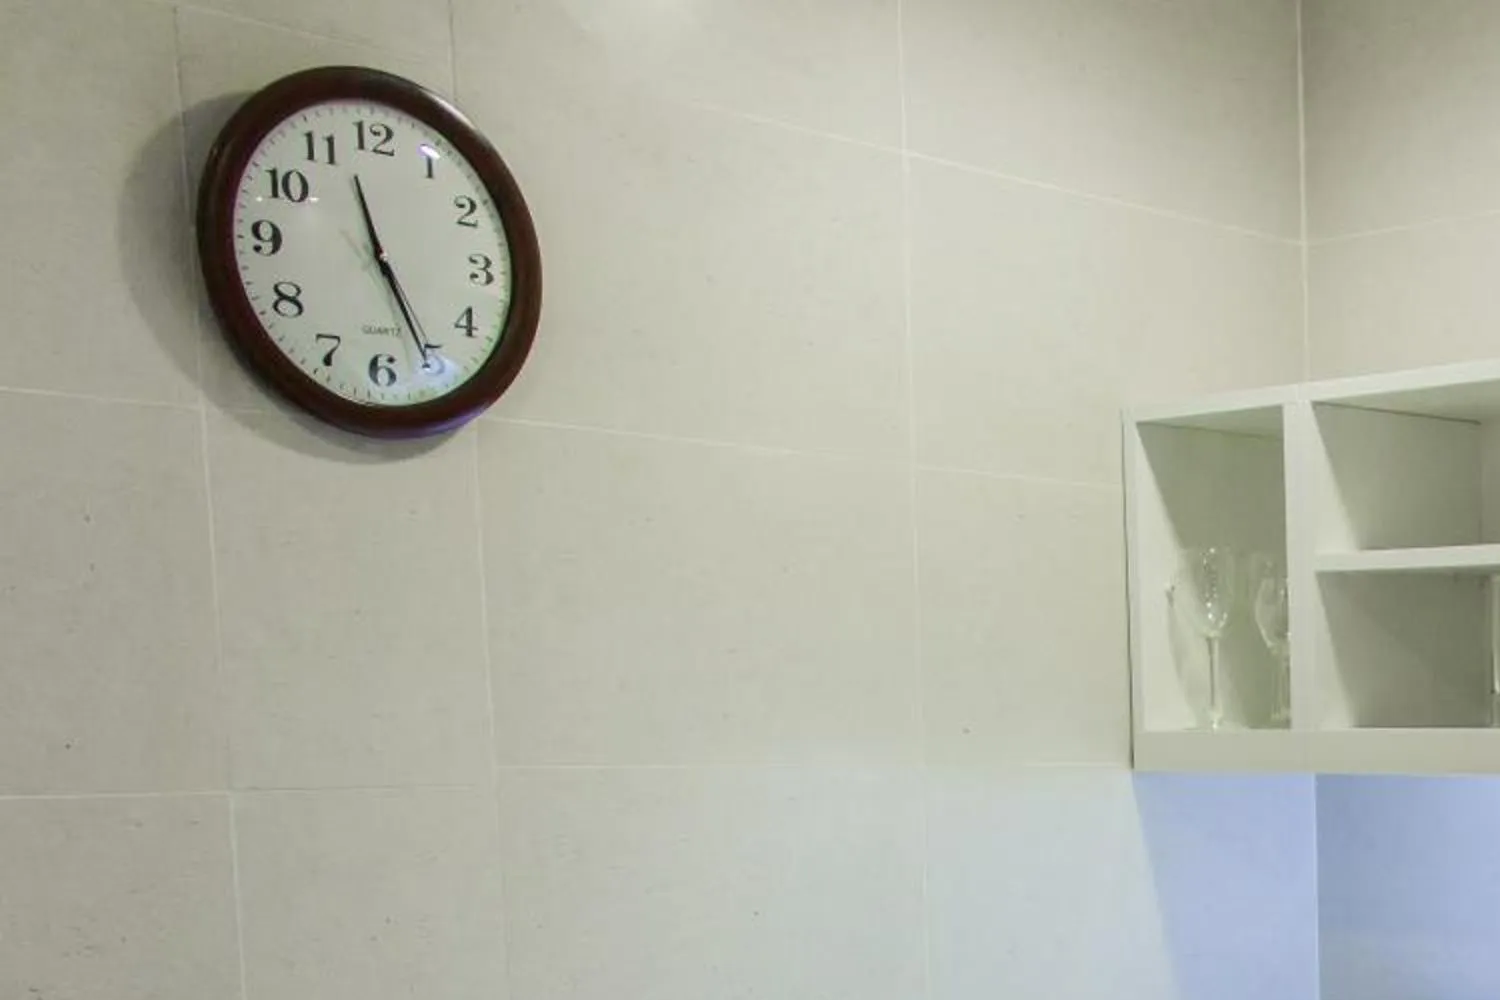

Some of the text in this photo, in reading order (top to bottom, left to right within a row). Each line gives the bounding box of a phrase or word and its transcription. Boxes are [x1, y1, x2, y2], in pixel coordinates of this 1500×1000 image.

[304, 131, 336, 166] 11
[353, 120, 396, 157] 12
[265, 168, 309, 204] 10
[454, 196, 480, 228] 2
[251, 219, 283, 256] 9
[468, 253, 495, 287] 3
[272, 281, 304, 318] 8
[454, 306, 479, 338] 4
[315, 333, 342, 367] 7
[421, 343, 446, 376] 5
[368, 353, 397, 387] 6
